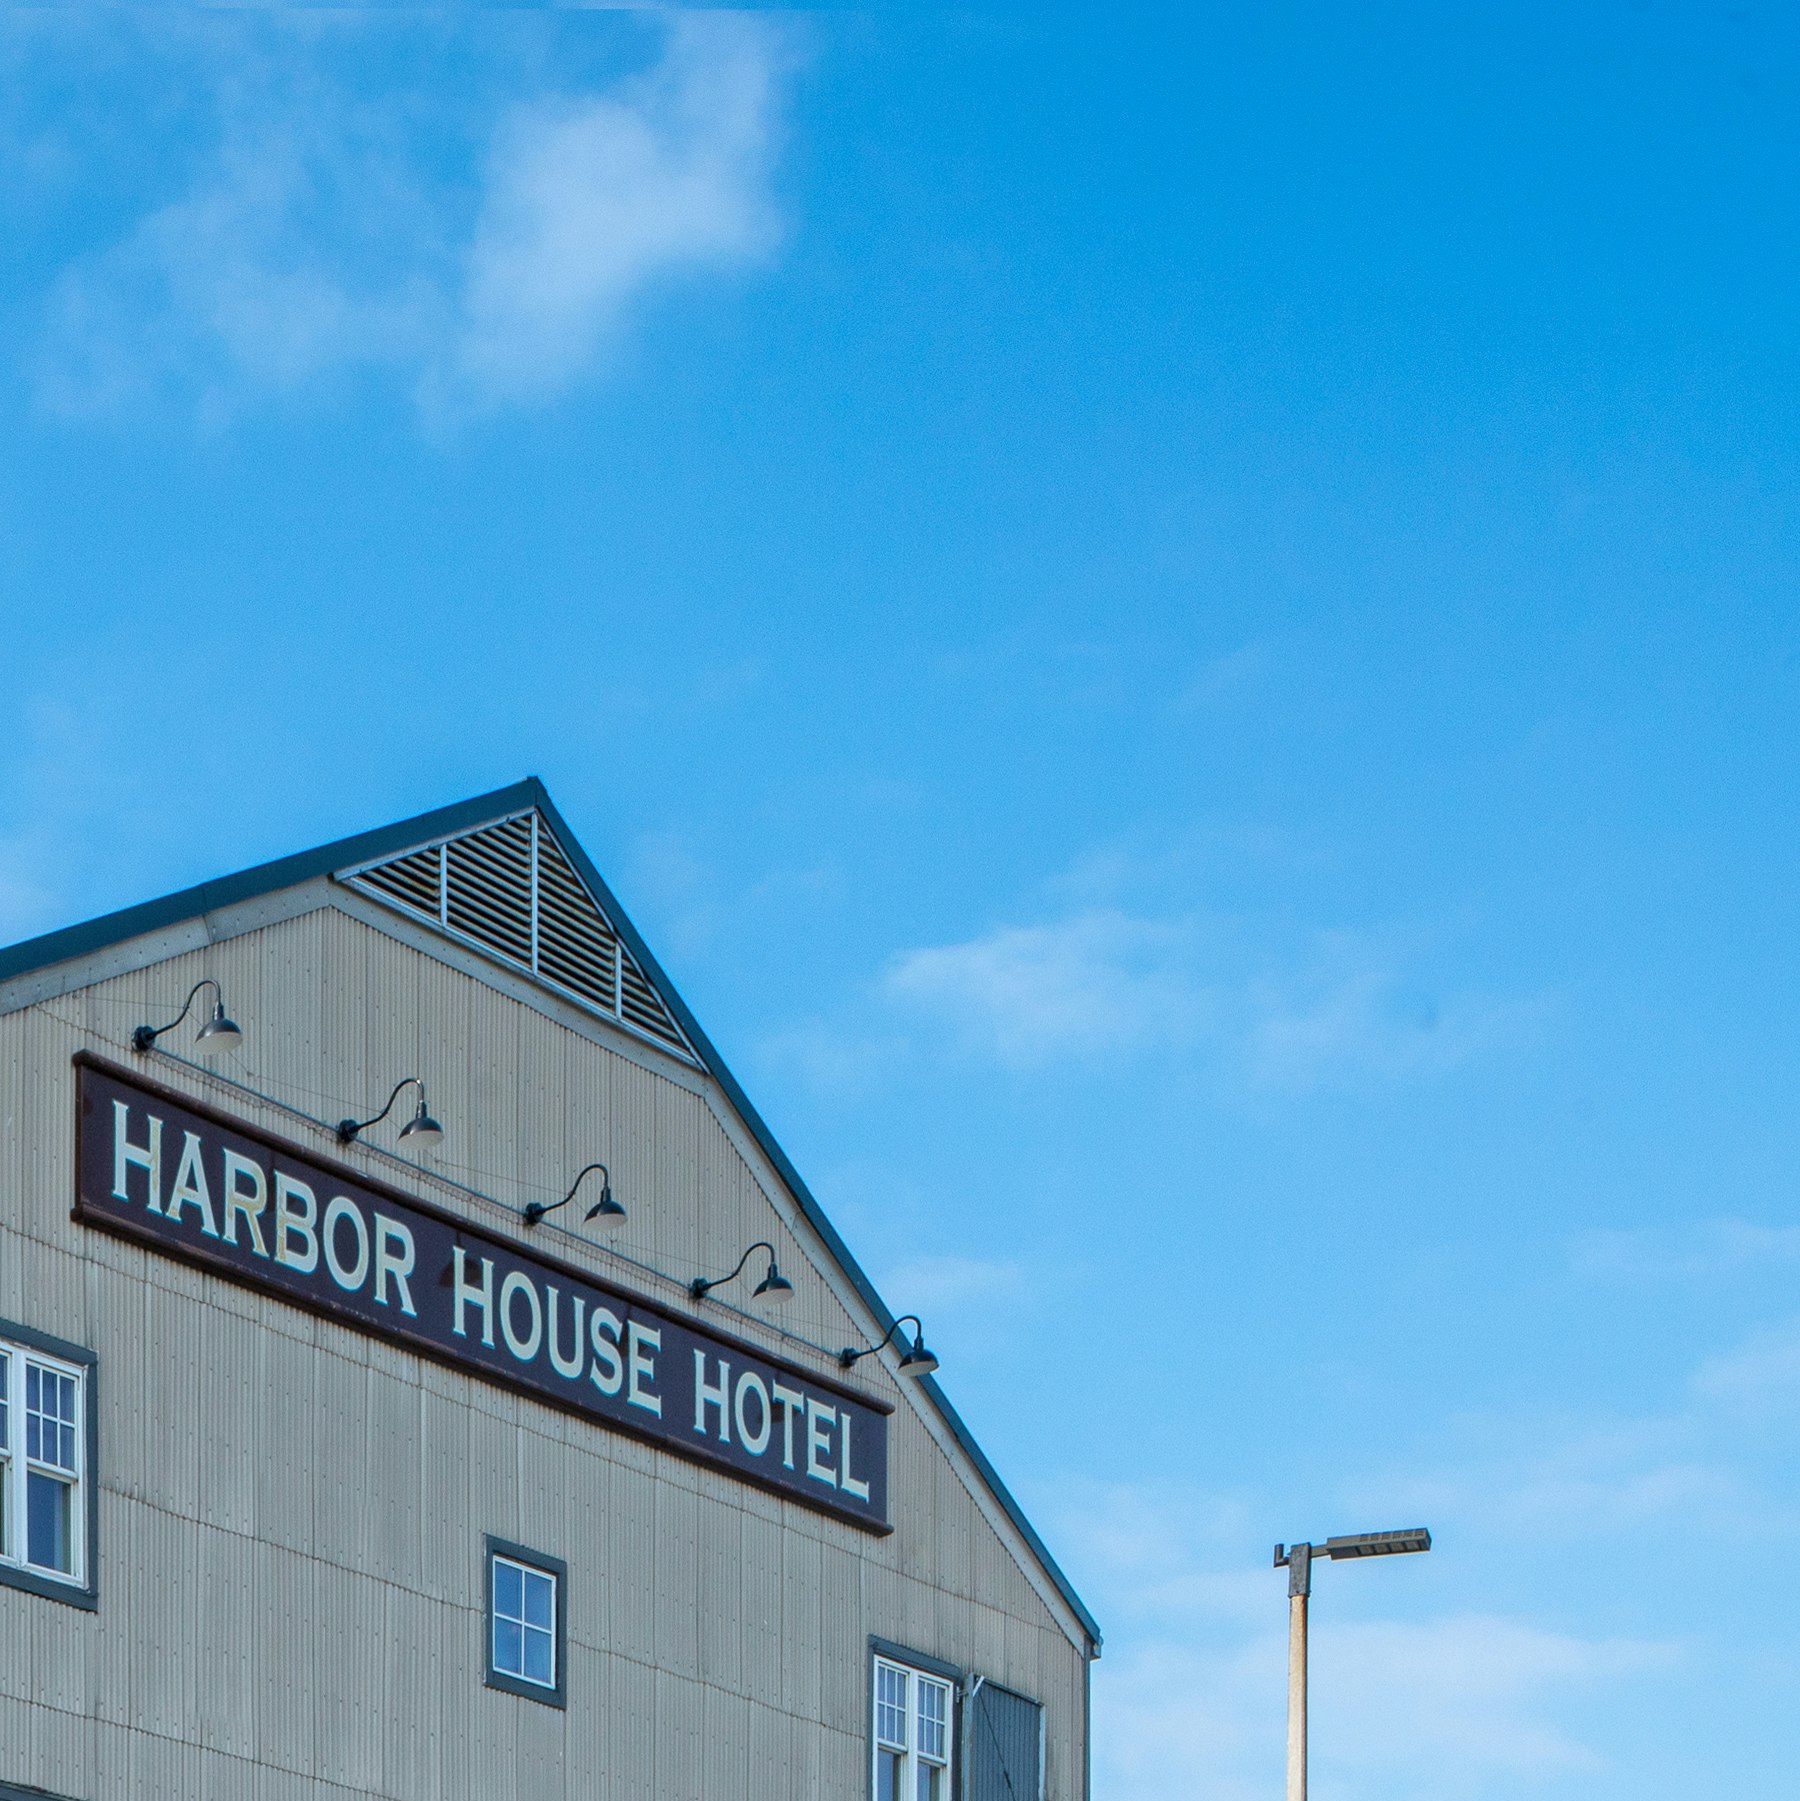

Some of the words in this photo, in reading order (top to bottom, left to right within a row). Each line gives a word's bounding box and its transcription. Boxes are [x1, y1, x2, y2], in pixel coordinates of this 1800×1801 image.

[111, 1098, 418, 1318] HARBOR
[452, 1245, 662, 1420] HOUSE
[693, 1347, 871, 1503] HOTEL
